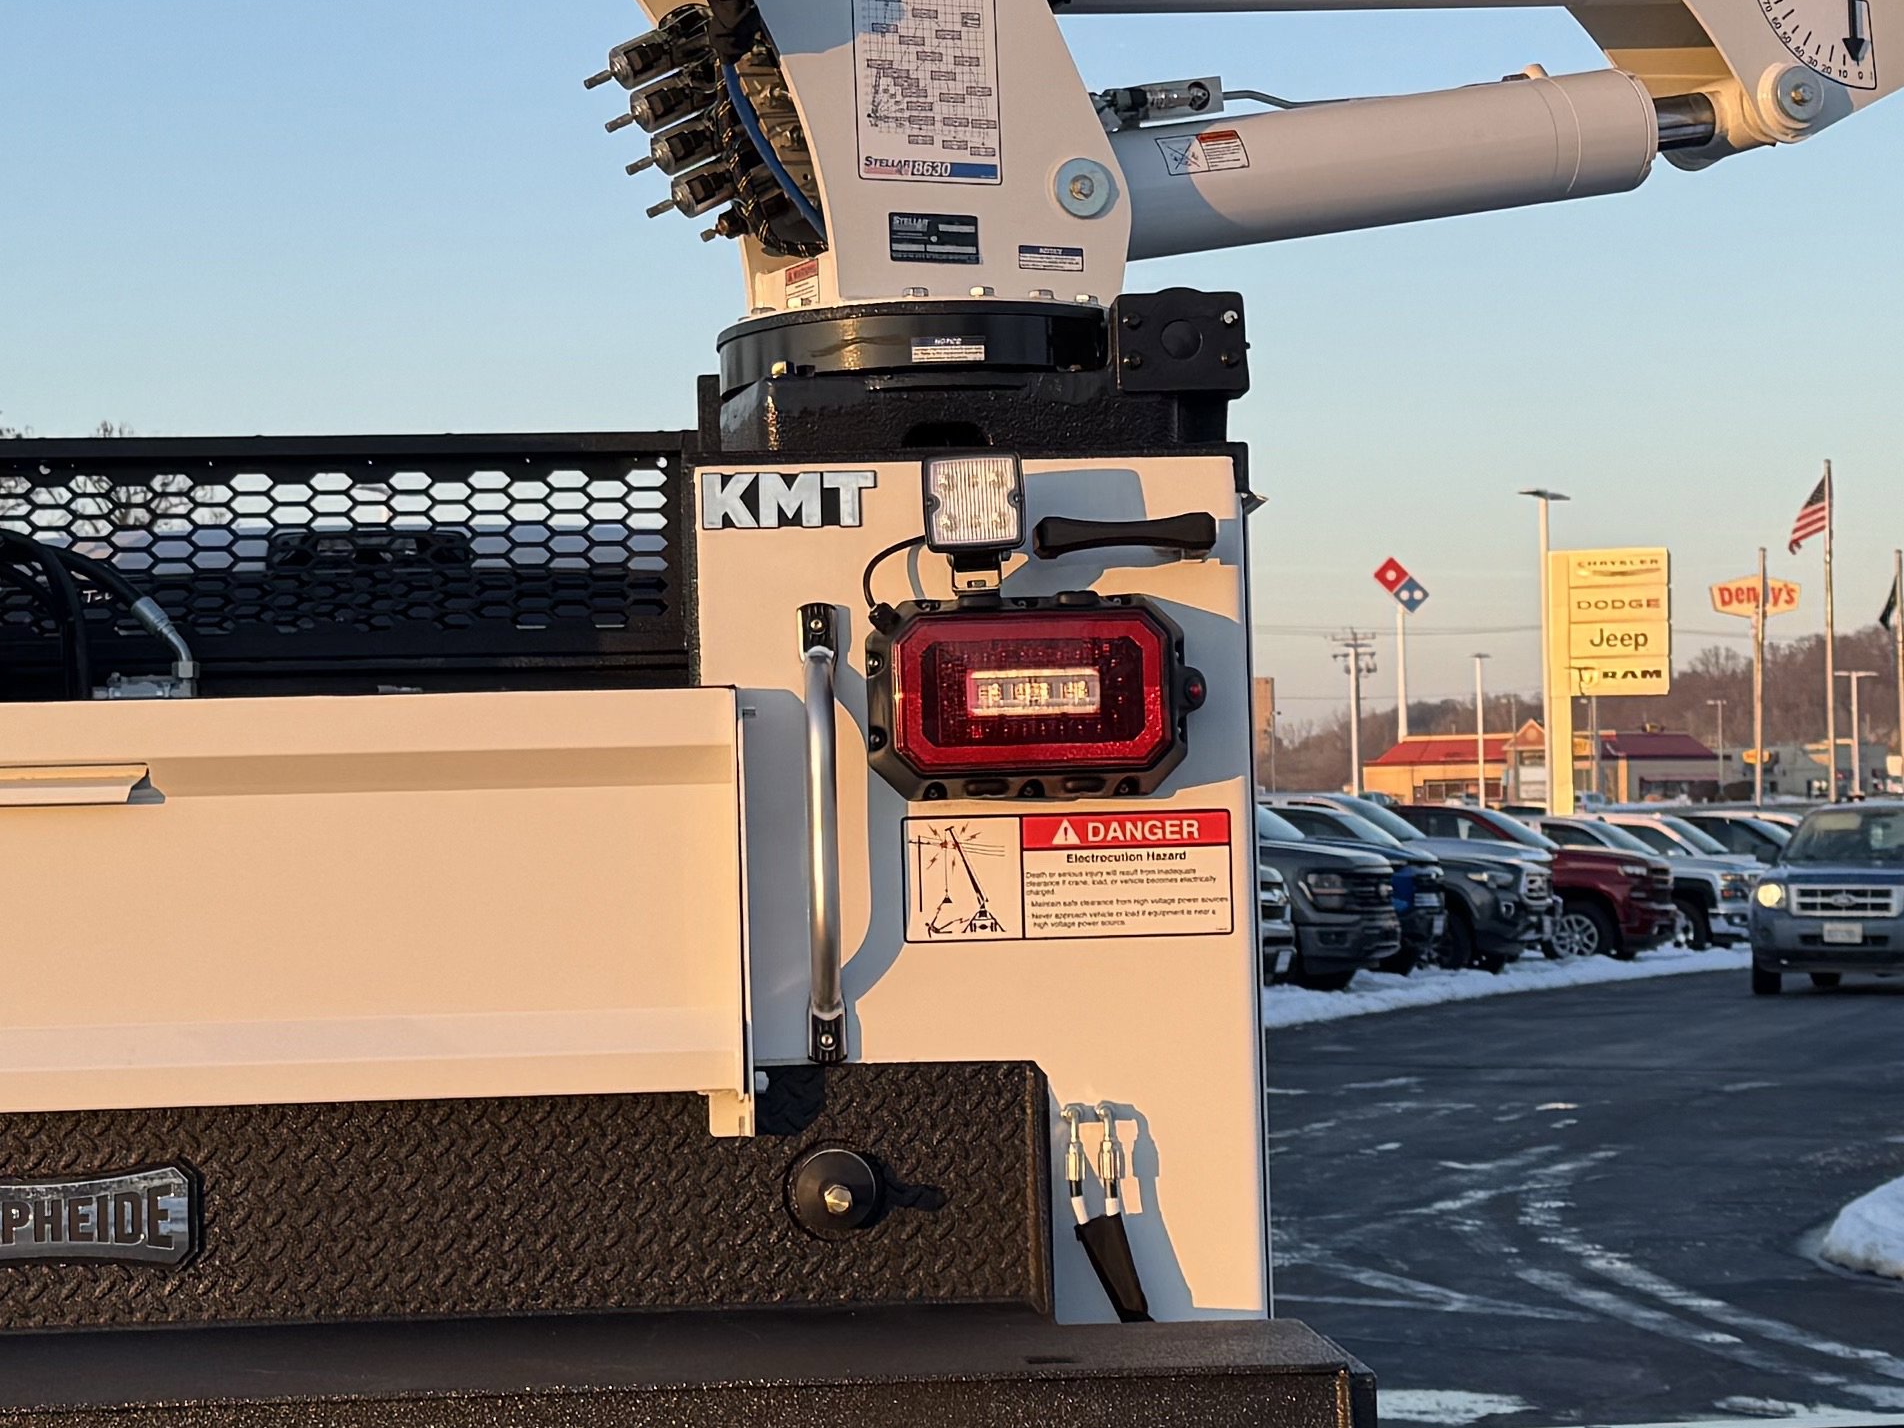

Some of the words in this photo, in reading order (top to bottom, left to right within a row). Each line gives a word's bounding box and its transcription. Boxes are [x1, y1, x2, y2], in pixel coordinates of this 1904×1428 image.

[1793, 45, 1805, 58] 40
[1806, 55, 1819, 68] 30
[1821, 63, 1833, 75] 20
[1838, 69, 1848, 79] 10
[864, 155, 910, 169] STELLAR
[913, 161, 952, 177] 8630
[701, 470, 878, 530] KMT
[1718, 583, 1797, 607] Deny's
[1576, 598, 1661, 610] DODGE
[1589, 628, 1649, 651] Jeep
[1602, 669, 1662, 679] RAM
[1087, 819, 1200, 842] DANGER
[1066, 852, 1143, 864] Electrocution
[1146, 850, 1187, 862] Hazard
